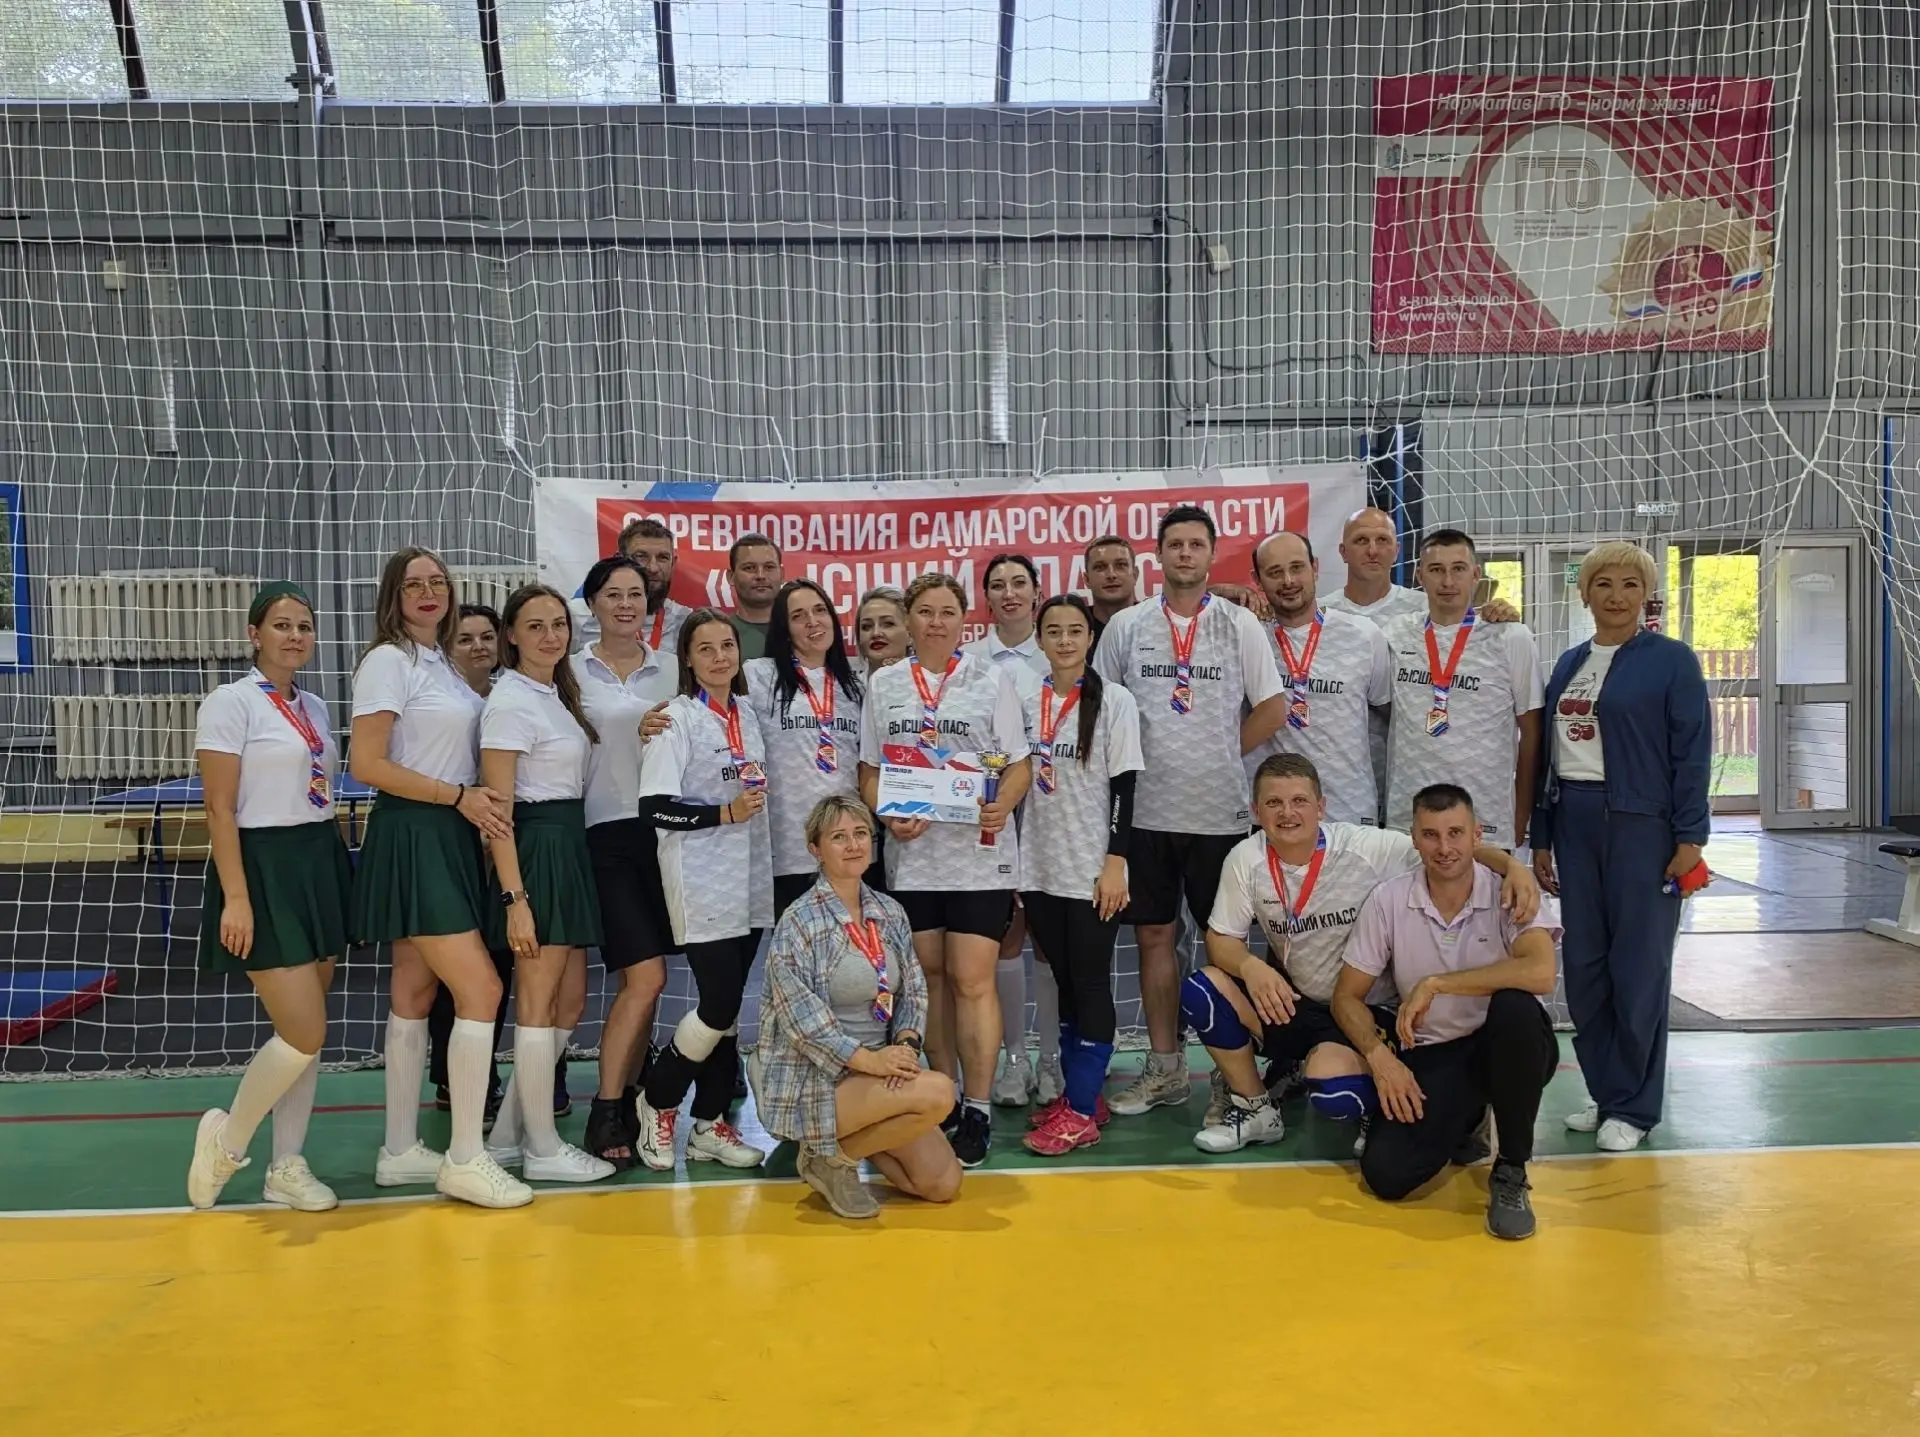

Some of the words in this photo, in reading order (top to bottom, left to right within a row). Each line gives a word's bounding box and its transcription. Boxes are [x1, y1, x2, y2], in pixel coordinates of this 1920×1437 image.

[1436, 92, 1532, 115] Норматив
[1537, 94, 1572, 110] ГТО
[1590, 97, 1646, 114] норма
[1650, 93, 1717, 111] жизни!
[1514, 156, 1601, 215] ГТО
[1399, 311, 1477, 324] www.gto.ru
[909, 496, 1118, 551] САМАРСКОЙ
[1127, 496, 1285, 541] ОАСТИ
[1140, 664, 1178, 679] ВЫСШ
[1188, 665, 1222, 681] КЛАСС
[1308, 678, 1344, 694] КЛАСС
[1451, 674, 1480, 691] ЛАСС
[781, 715, 821, 731] ВЫСШ
[888, 719, 921, 736] ВЫСШ
[1054, 743, 1082, 760] КЛАС
[1319, 907, 1358, 929] КЛАСС
